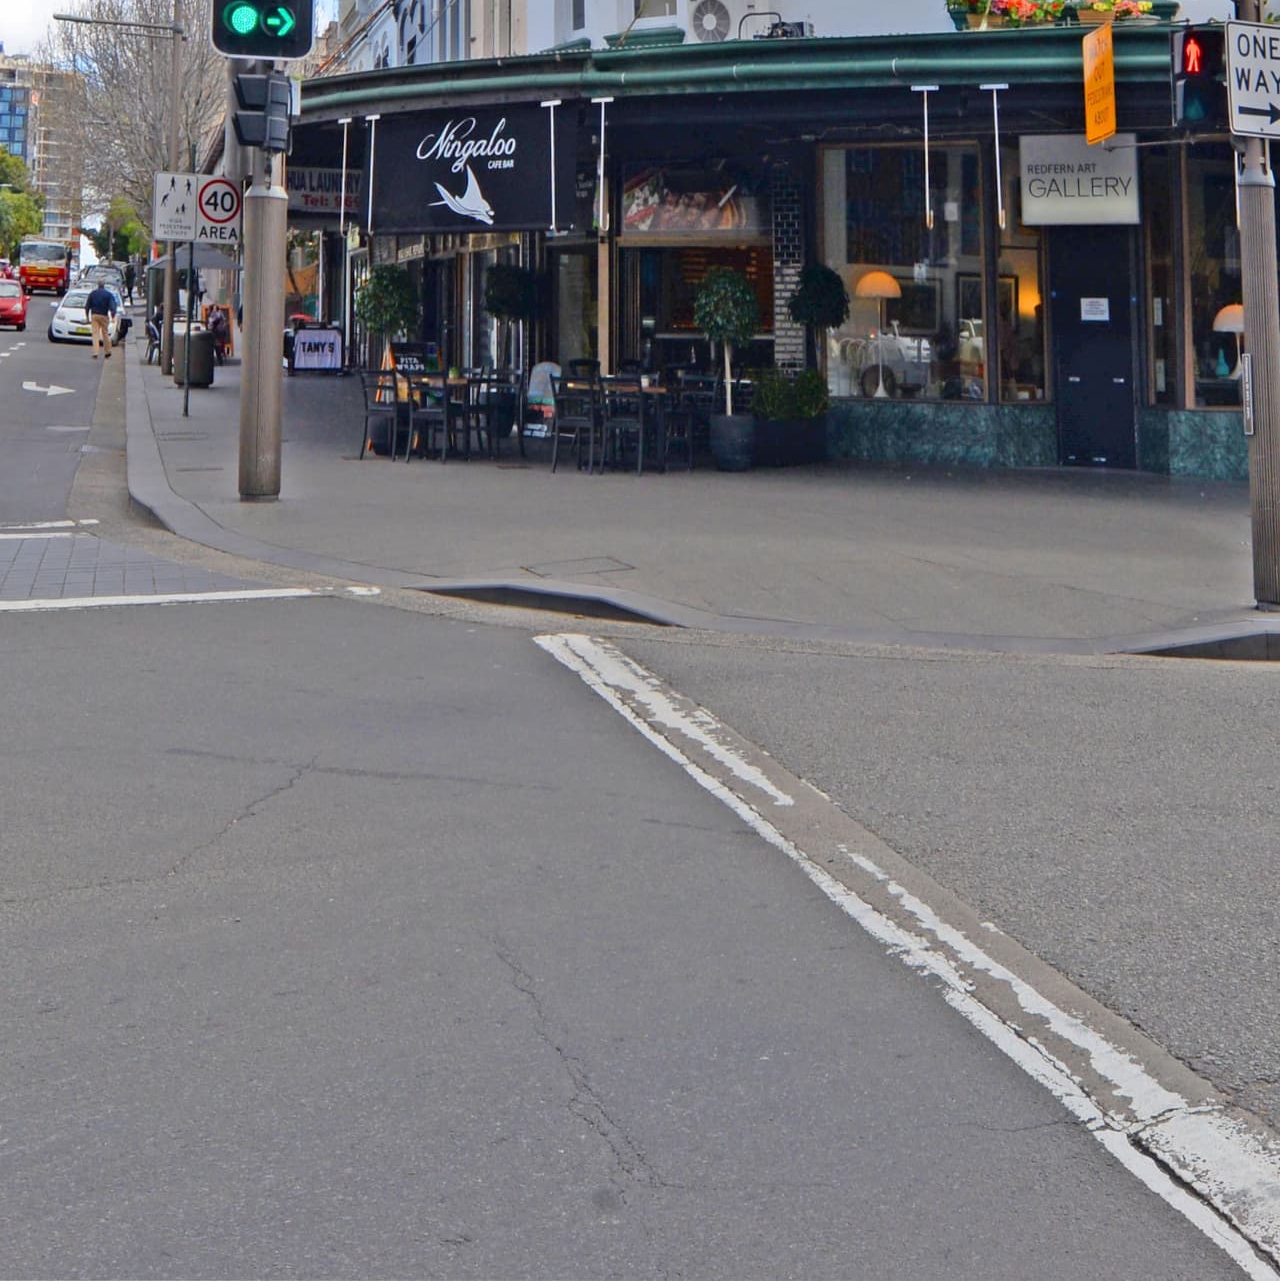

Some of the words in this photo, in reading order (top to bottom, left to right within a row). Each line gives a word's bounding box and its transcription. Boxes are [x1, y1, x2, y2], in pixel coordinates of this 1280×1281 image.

[416, 117, 516, 173] Ningaloo
[487, 159, 502, 169] CAFE
[502, 159, 515, 169] BAR
[1027, 163, 1075, 175] REDFERN
[1076, 162, 1097, 174] ART
[308, 171, 361, 194] LAUNRY
[1028, 176, 1133, 198] GALLERY
[204, 190, 235, 213] 40
[198, 226, 239, 241] AREA
